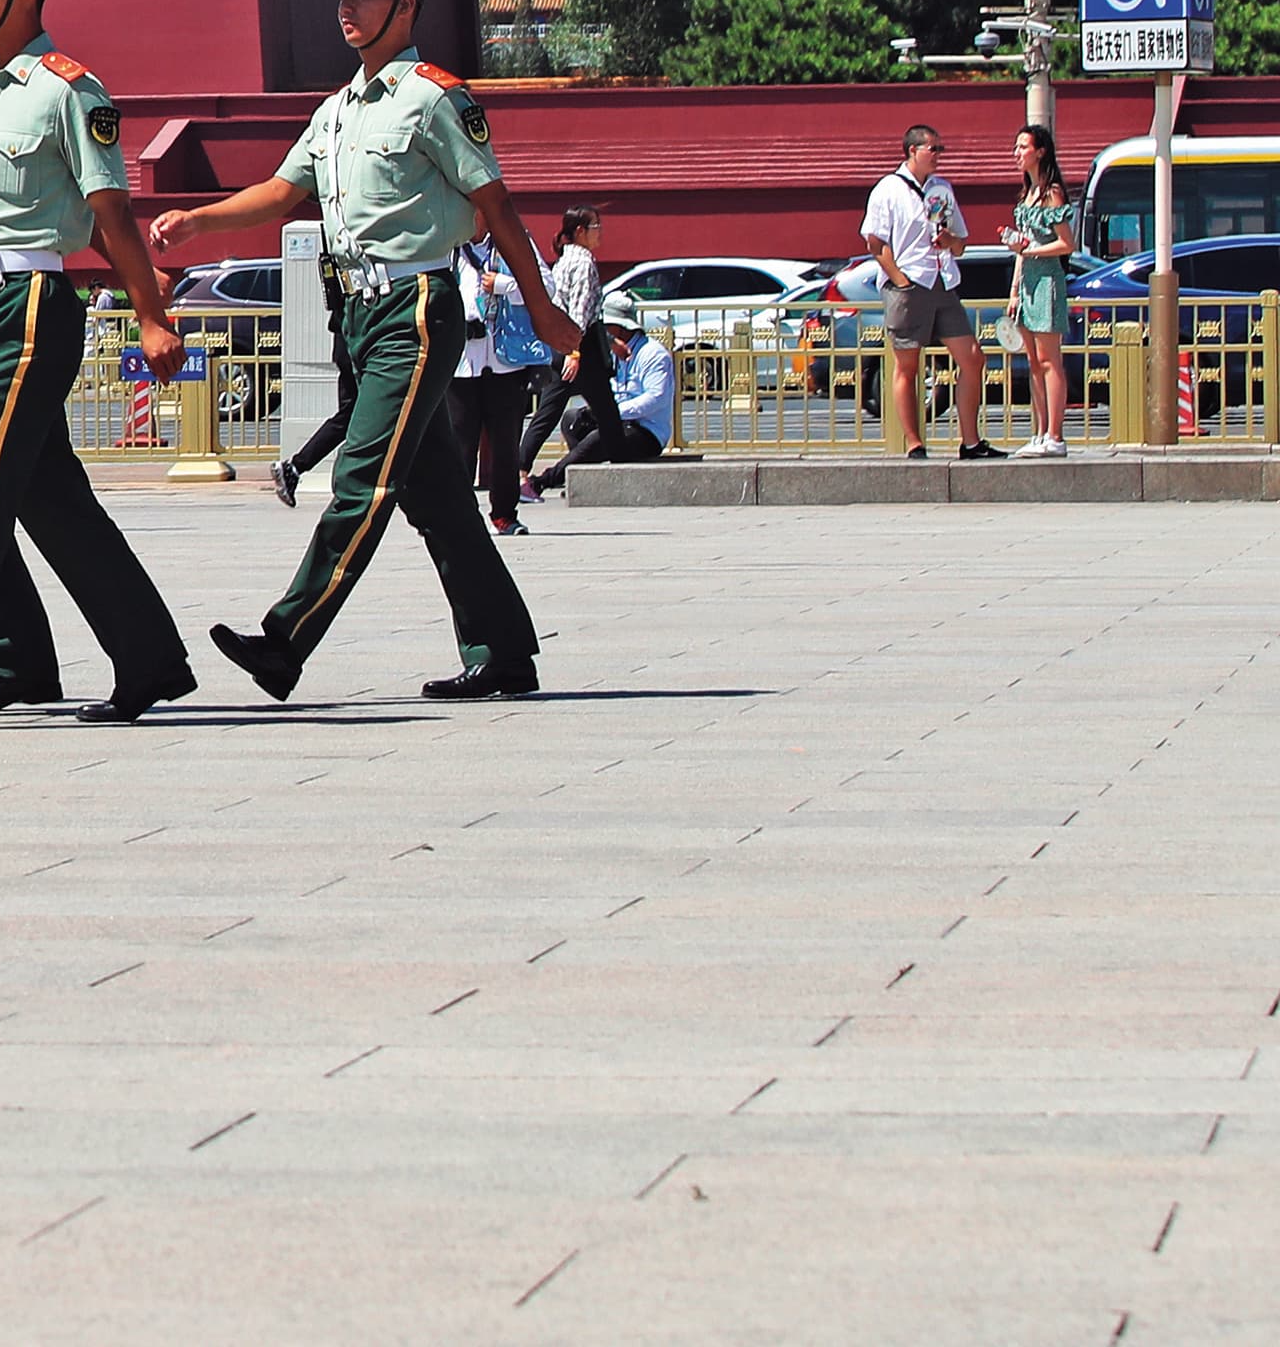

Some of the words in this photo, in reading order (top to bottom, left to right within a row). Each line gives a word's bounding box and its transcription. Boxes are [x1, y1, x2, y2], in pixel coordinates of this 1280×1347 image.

[1086, 28, 1184, 62] 通往天安门、国家博物馆
